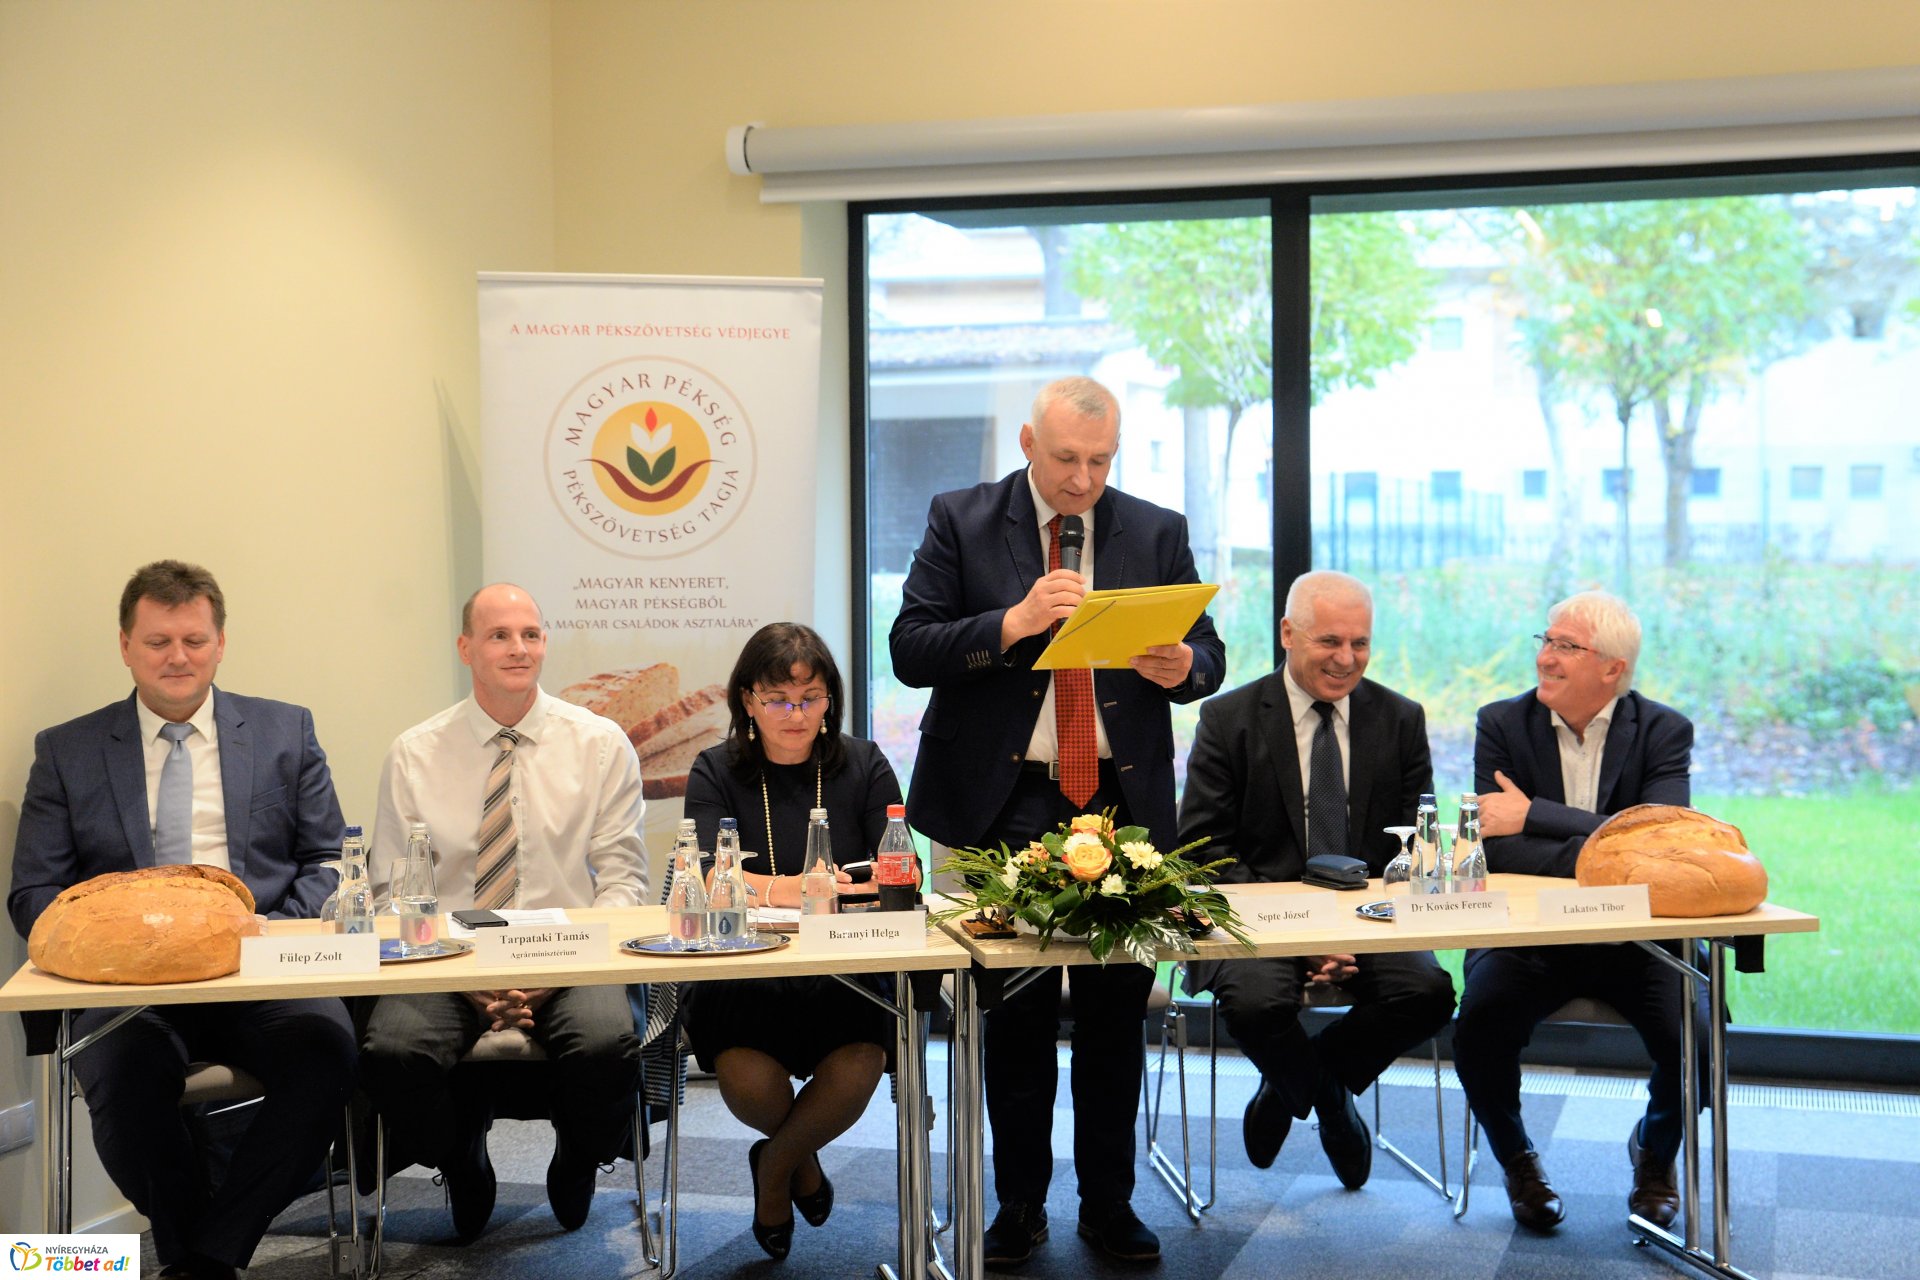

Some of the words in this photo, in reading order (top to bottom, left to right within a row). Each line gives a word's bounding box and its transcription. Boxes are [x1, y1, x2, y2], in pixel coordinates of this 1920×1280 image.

[510, 324, 520, 335] A
[526, 324, 590, 336] MAGYAR
[596, 322, 712, 338] PÉKSZÖVETSÉG
[718, 324, 790, 341] VÉDJEGYE
[565, 373, 651, 446] MAGYAR
[663, 375, 737, 446] PÉKSÉG
[562, 469, 697, 543] PÉKSZÖVETSÉG
[697, 469, 740, 523] TAGJA
[649, 576, 729, 590] KENYERET,
[575, 598, 638, 609] MAGYAR
[644, 595, 727, 609] PÉKSÉGBŐL
[555, 619, 608, 630] MAGYAR
[612, 617, 680, 629] CSALÁDOK
[1411, 903, 1424, 912] Dr
[1426, 901, 1459, 911] Kovács
[1461, 900, 1493, 909] Ferenc
[1563, 904, 1599, 914] Lakatos
[1600, 902, 1626, 912] Tibor
[1257, 912, 1281, 923] Septe
[1283, 909, 1311, 920] József
[499, 933, 552, 946] Tarpataki
[554, 931, 590, 942] Tamás
[829, 929, 868, 941] Baranyi
[871, 928, 900, 939] Helga
[279, 952, 311, 965] Fülep
[314, 951, 343, 962] Zsolt
[510, 950, 577, 960] Agrárminisztérium
